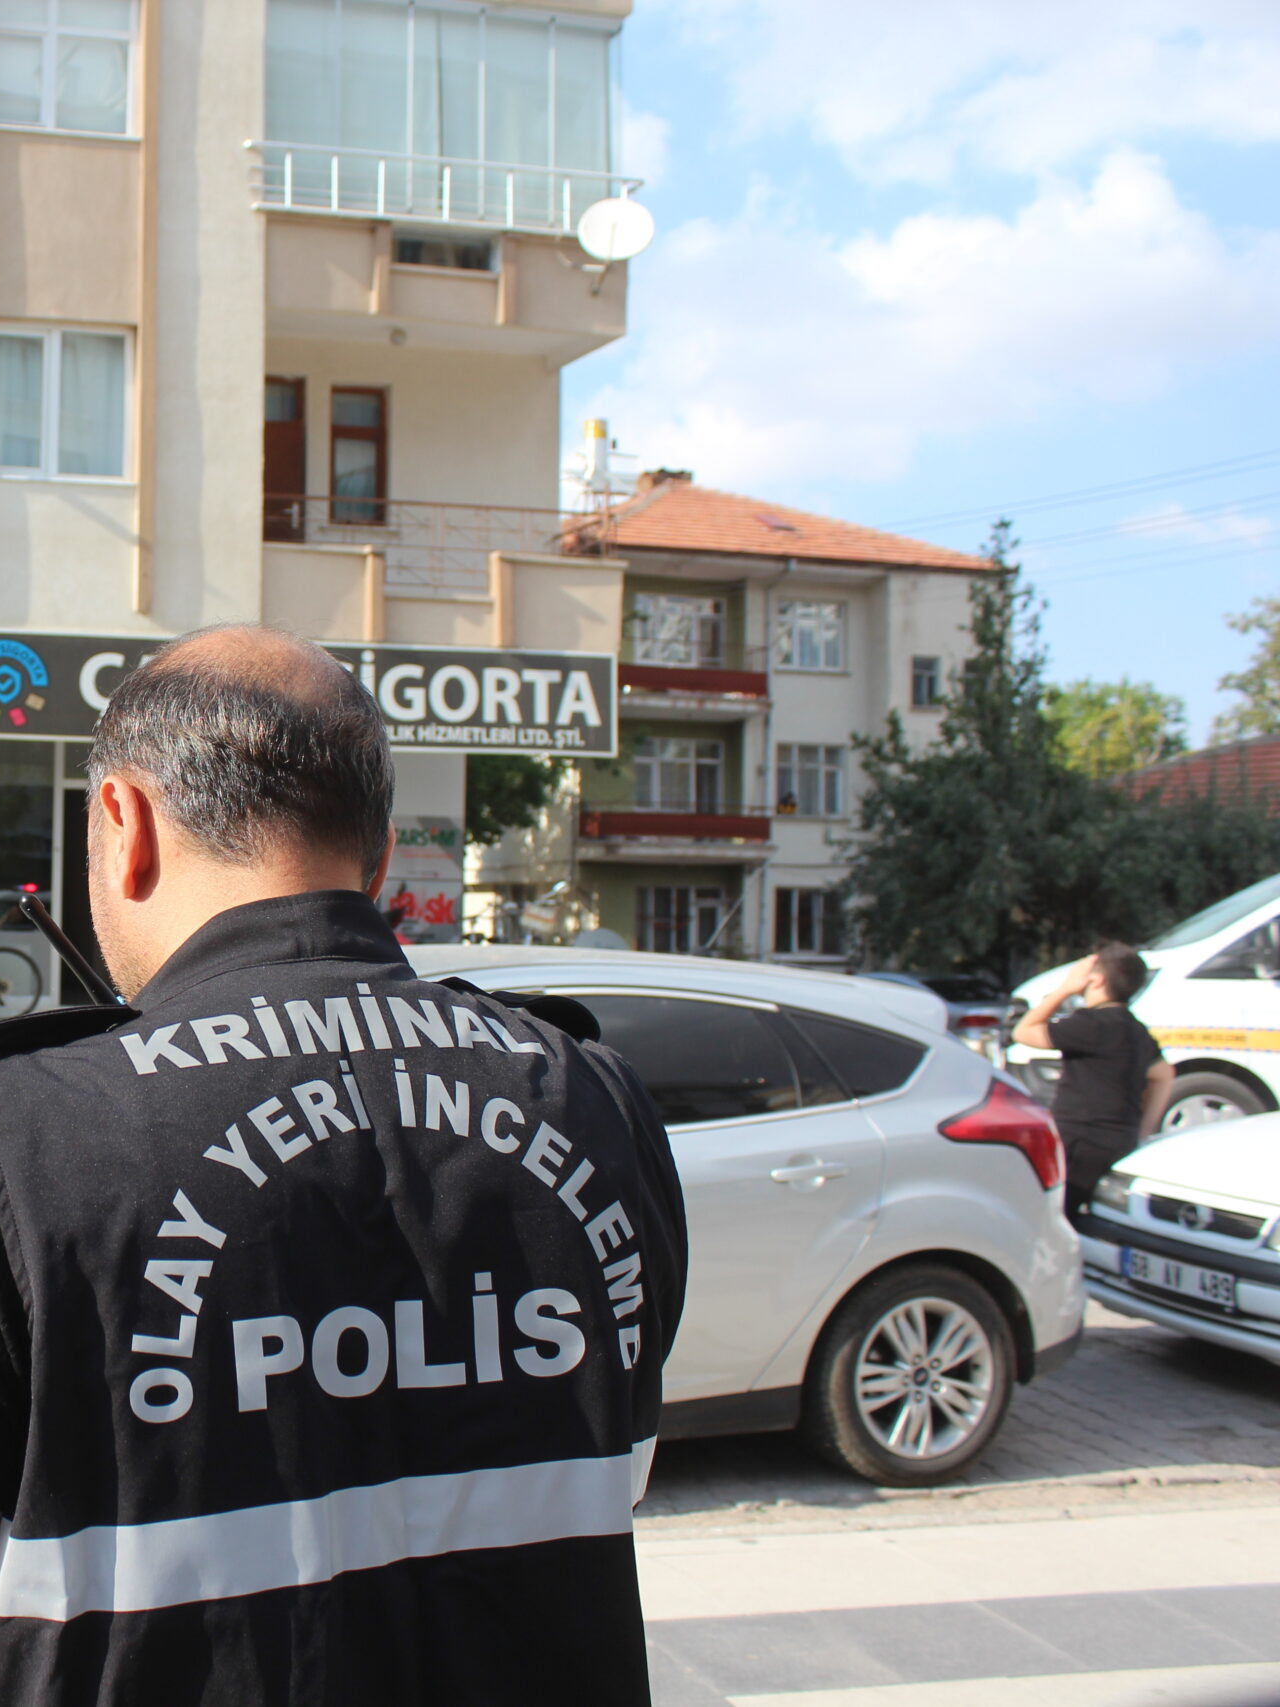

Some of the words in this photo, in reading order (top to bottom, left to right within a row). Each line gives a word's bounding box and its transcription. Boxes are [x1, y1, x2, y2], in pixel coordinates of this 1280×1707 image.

[342, 650, 602, 727] İGORTA
[419, 722, 517, 745] HİZMETLERİ
[518, 727, 553, 746] LTD.
[554, 726, 586, 749] ŞTİ.
[120, 983, 546, 1075] KRİMİNAL
[129, 1189, 228, 1424] OLAY
[202, 1060, 372, 1189] YERİ
[394, 1058, 644, 1370] İNCELEME
[232, 1272, 586, 1412] POLİS
